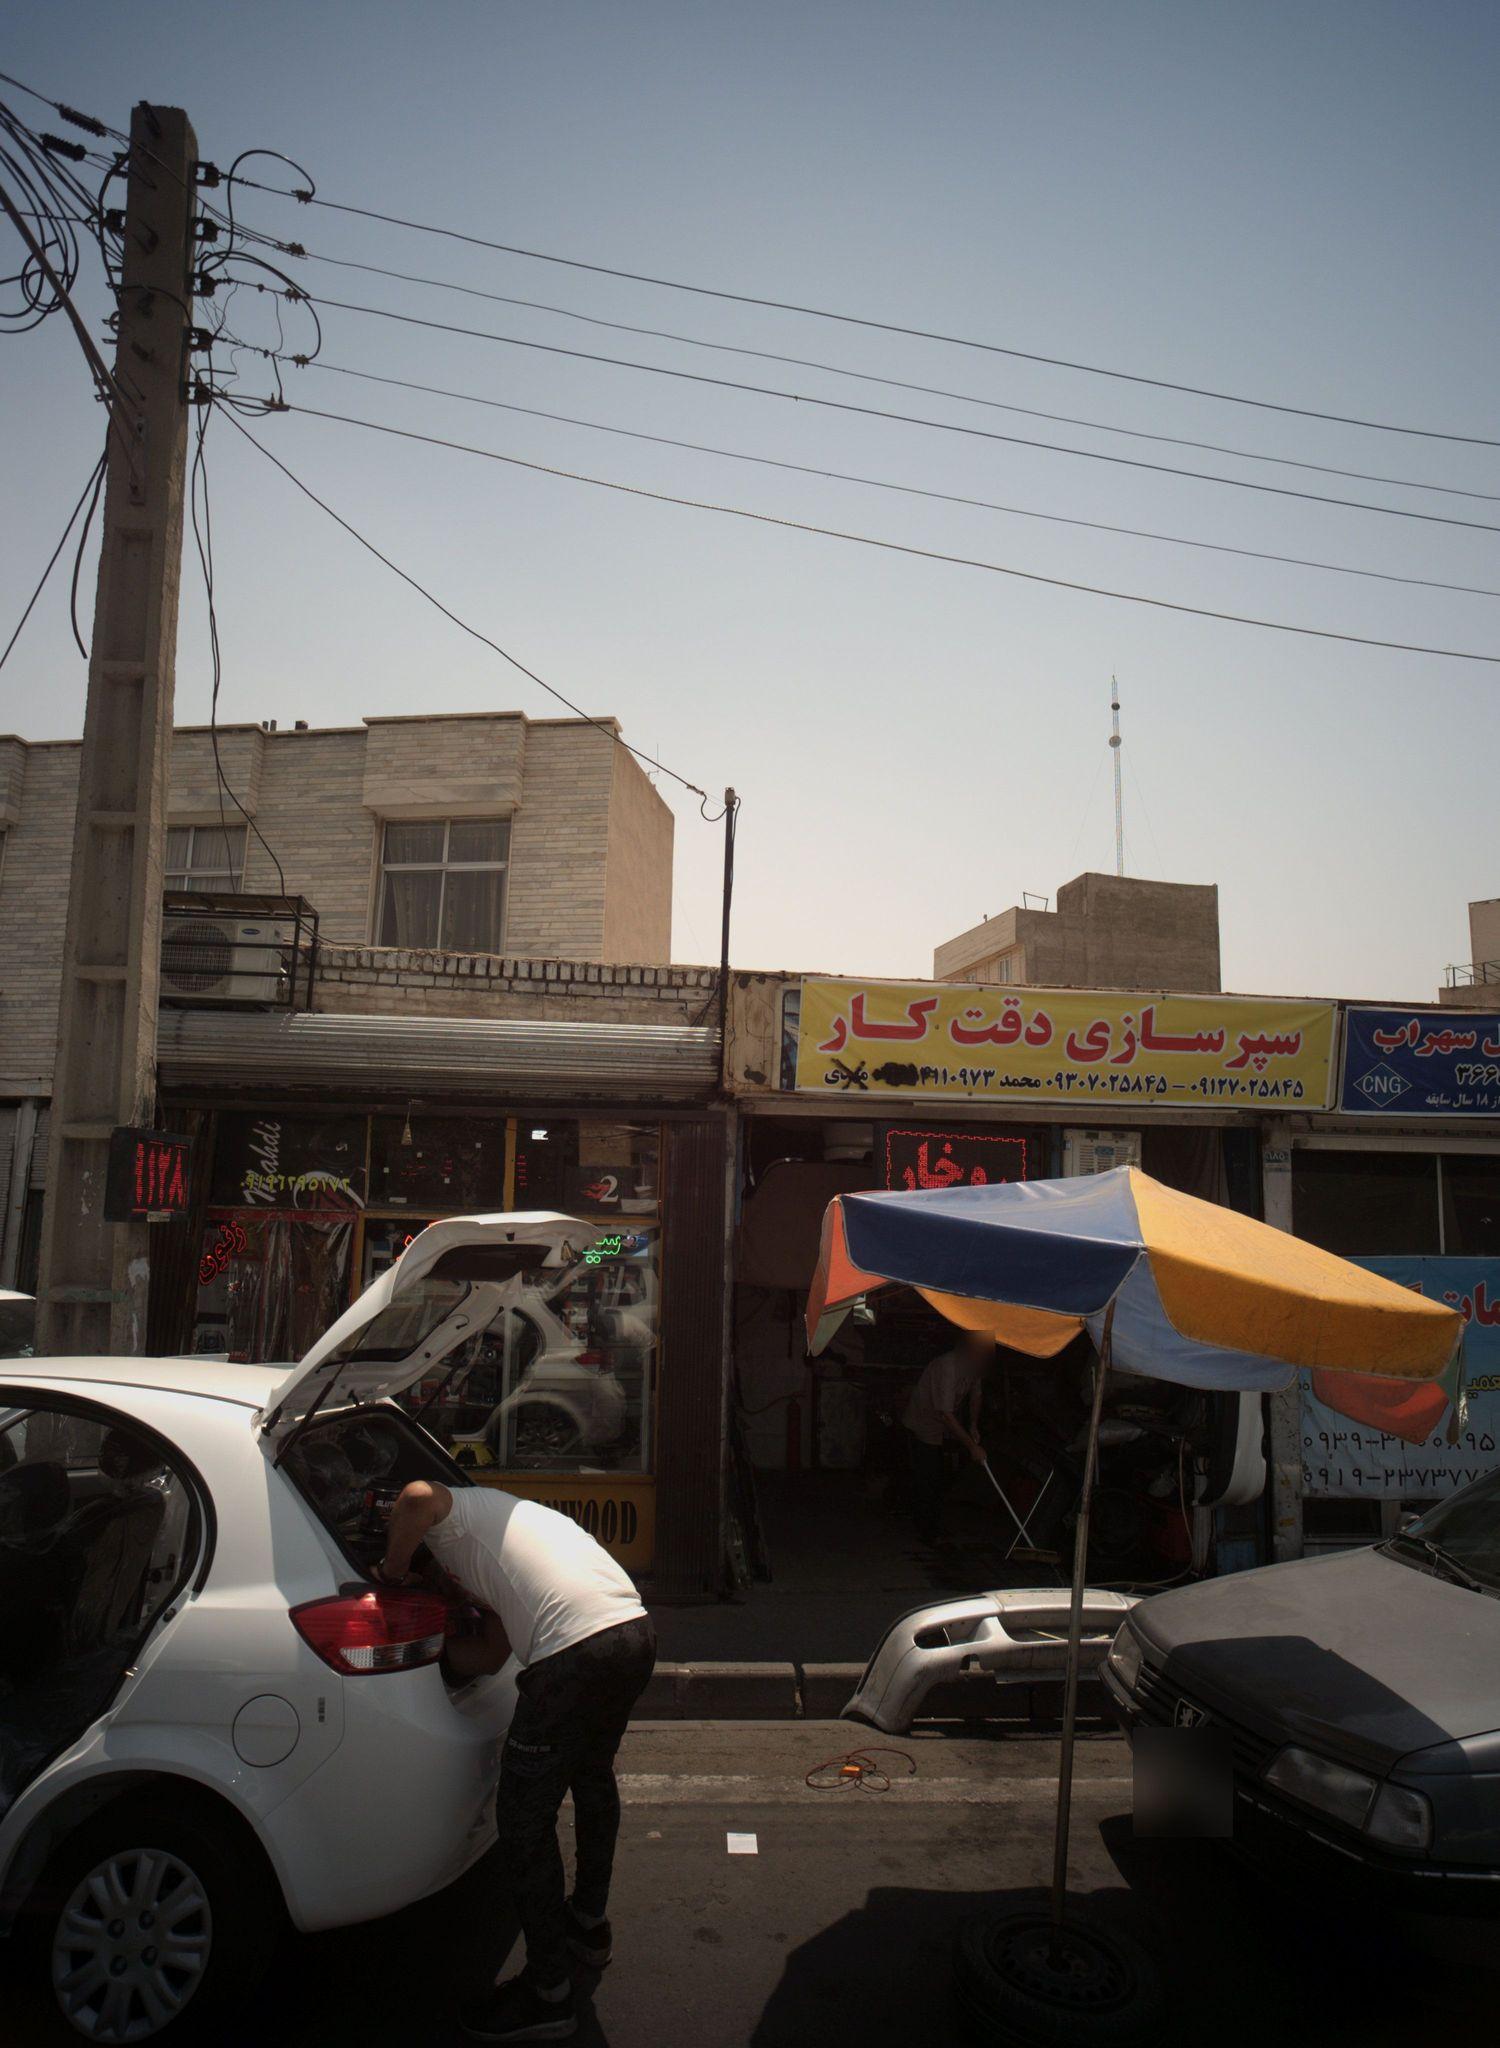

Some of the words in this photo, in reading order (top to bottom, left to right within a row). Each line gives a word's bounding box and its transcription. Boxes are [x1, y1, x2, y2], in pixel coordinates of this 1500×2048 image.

[817, 992, 939, 1052] کار
[949, 997, 1053, 1046] دقت
[1064, 1005, 1226, 1065] سازی
[1373, 1018, 1477, 1057] سهراب
[1224, 1028, 1302, 1073] سپر
[999, 1075, 1041, 1088] محمد
[1361, 1075, 1401, 1095] CNG
